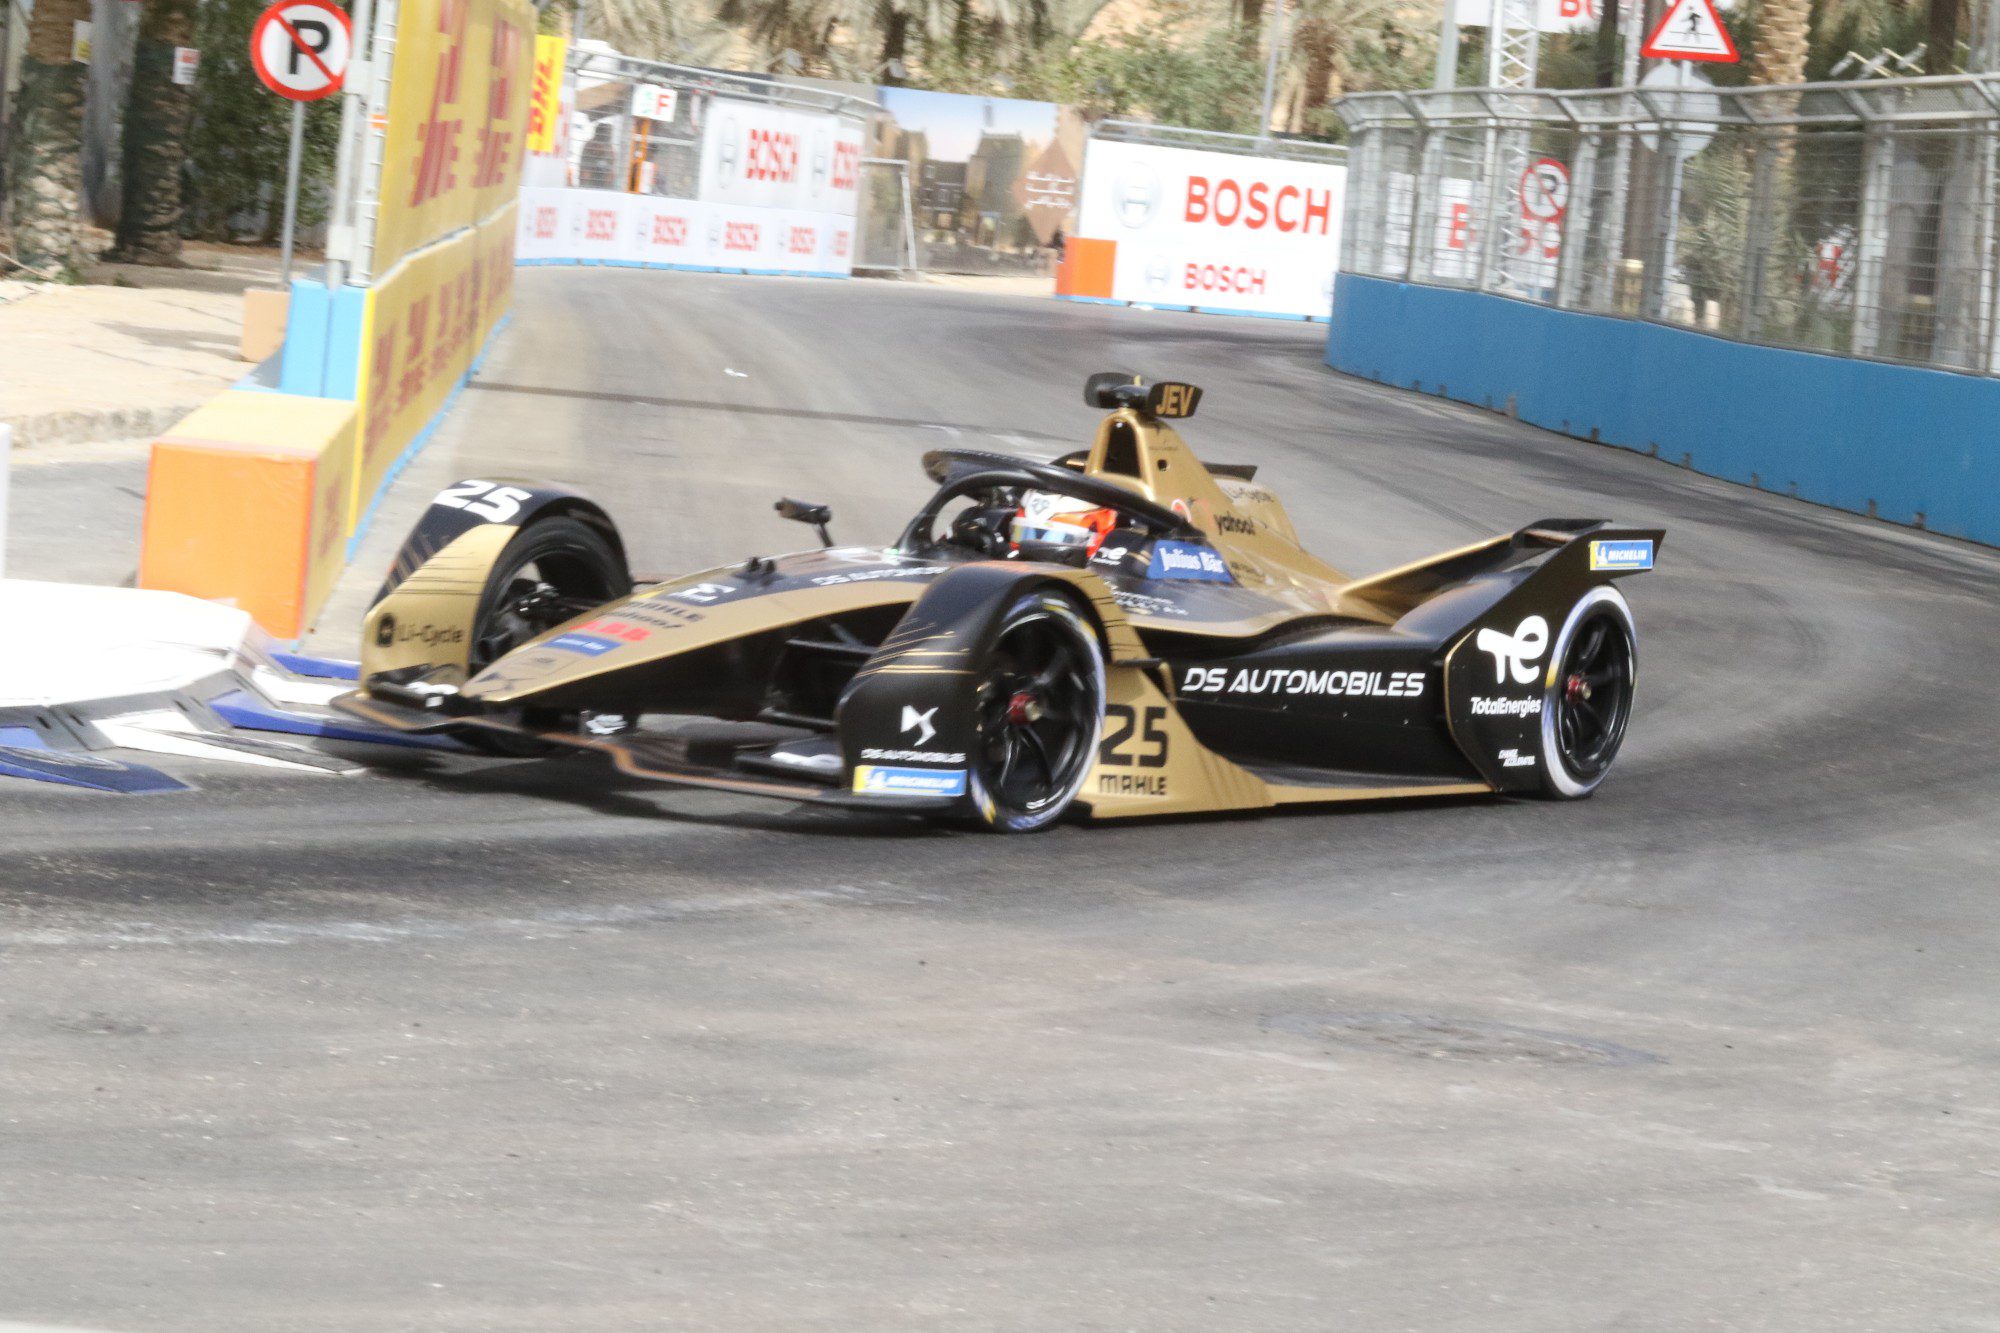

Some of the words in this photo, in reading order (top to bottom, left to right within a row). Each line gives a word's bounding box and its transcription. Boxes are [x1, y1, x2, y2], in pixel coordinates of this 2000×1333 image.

[289, 20, 330, 75] P
[1184, 175, 1331, 235] BOSCH
[1184, 263, 1266, 294] BOSCH
[1156, 384, 1195, 416] JEV
[432, 479, 533, 523] 25
[1608, 549, 1648, 561] MICHELIN
[1182, 667, 1229, 693] DS
[1228, 669, 1426, 698] AUTOMOBILES
[1470, 695, 1542, 718] TotalEnergies
[1100, 704, 1169, 768] 25
[1099, 774, 1169, 796] MAHLE
